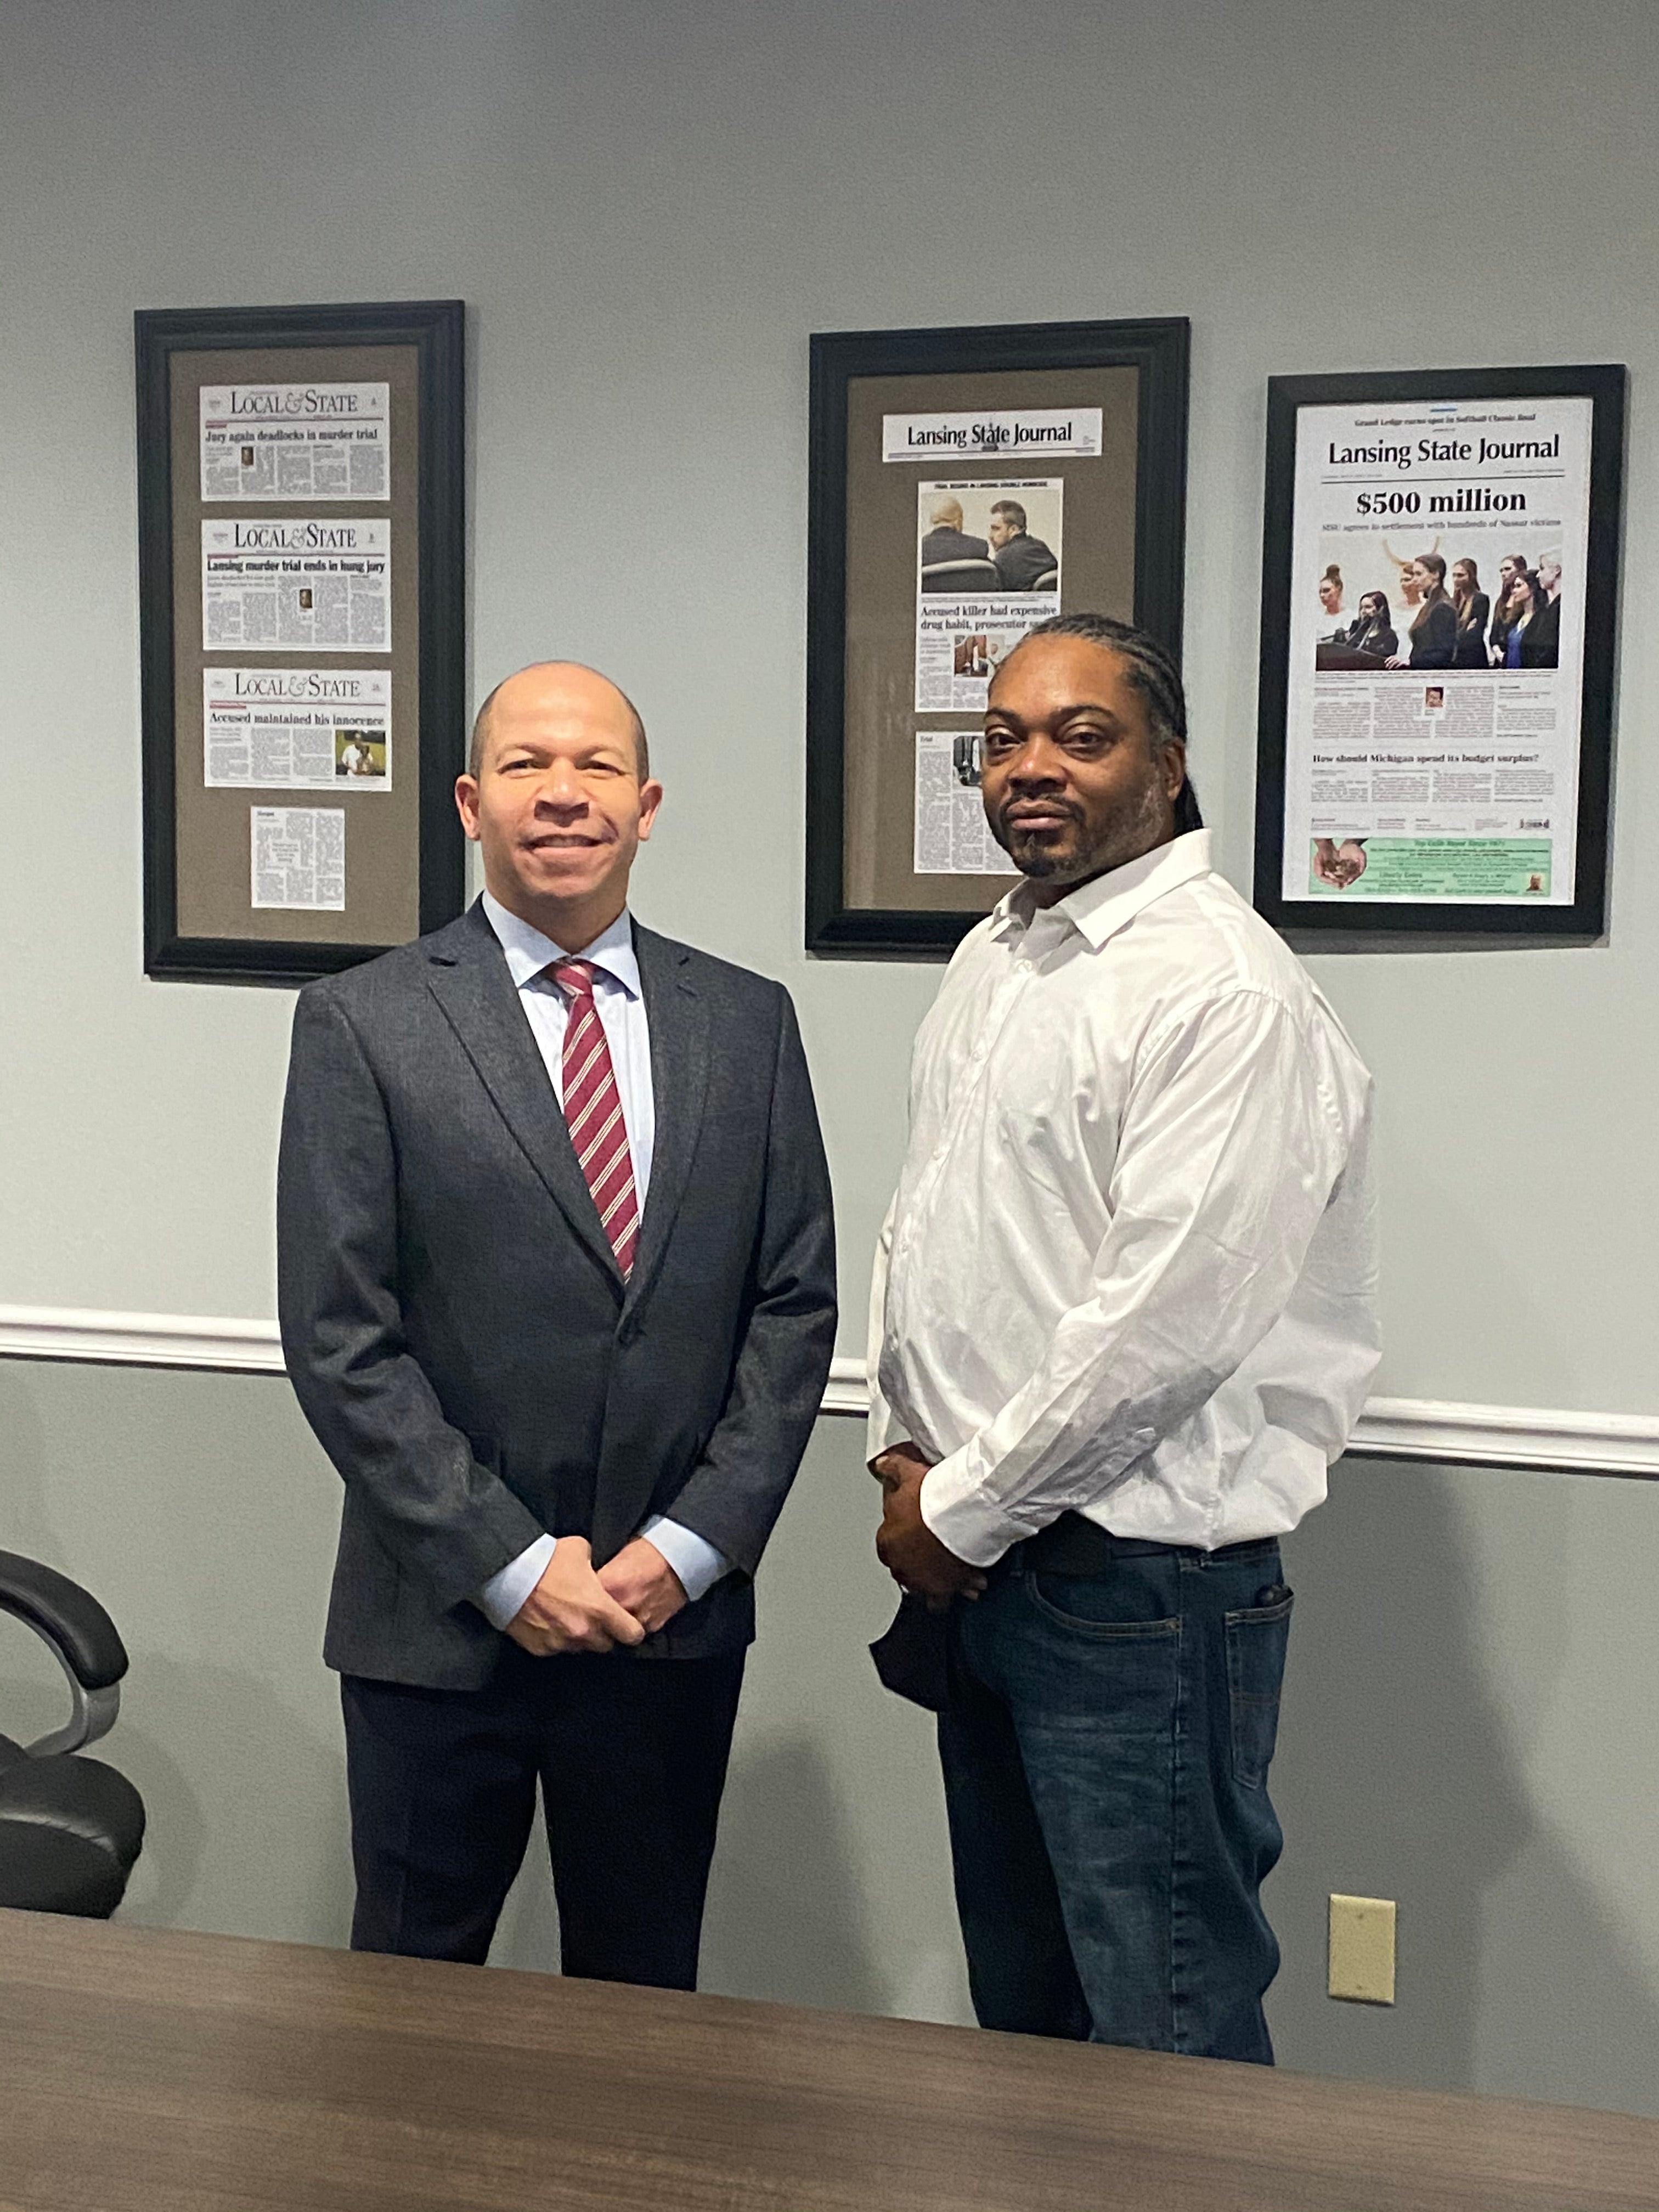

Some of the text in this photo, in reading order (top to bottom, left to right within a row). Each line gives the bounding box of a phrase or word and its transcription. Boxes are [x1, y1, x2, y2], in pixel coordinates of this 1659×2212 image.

[205, 427, 378, 444] Jury again deadlocks in murder trial
[908, 421, 1072, 447] Lansing State Journal
[1329, 433, 1560, 470] Lansing State Journal
[1357, 488, 1526, 517] $500 million
[207, 560, 385, 574] Lansing murder trial ends in hung jury
[921, 605, 1058, 616] Accused killer had expensive
[921, 619, 943, 630] drug
[945, 619, 972, 630] habit,
[974, 619, 1026, 631] prosecutor
[210, 713, 384, 726] Accused maintained his innocence
[1336, 754, 1368, 763] should
[1369, 754, 1414, 764] Michigan
[1417, 754, 1445, 764] spend
[1462, 754, 1494, 763] budget
[1497, 754, 1539, 764] surplus?
